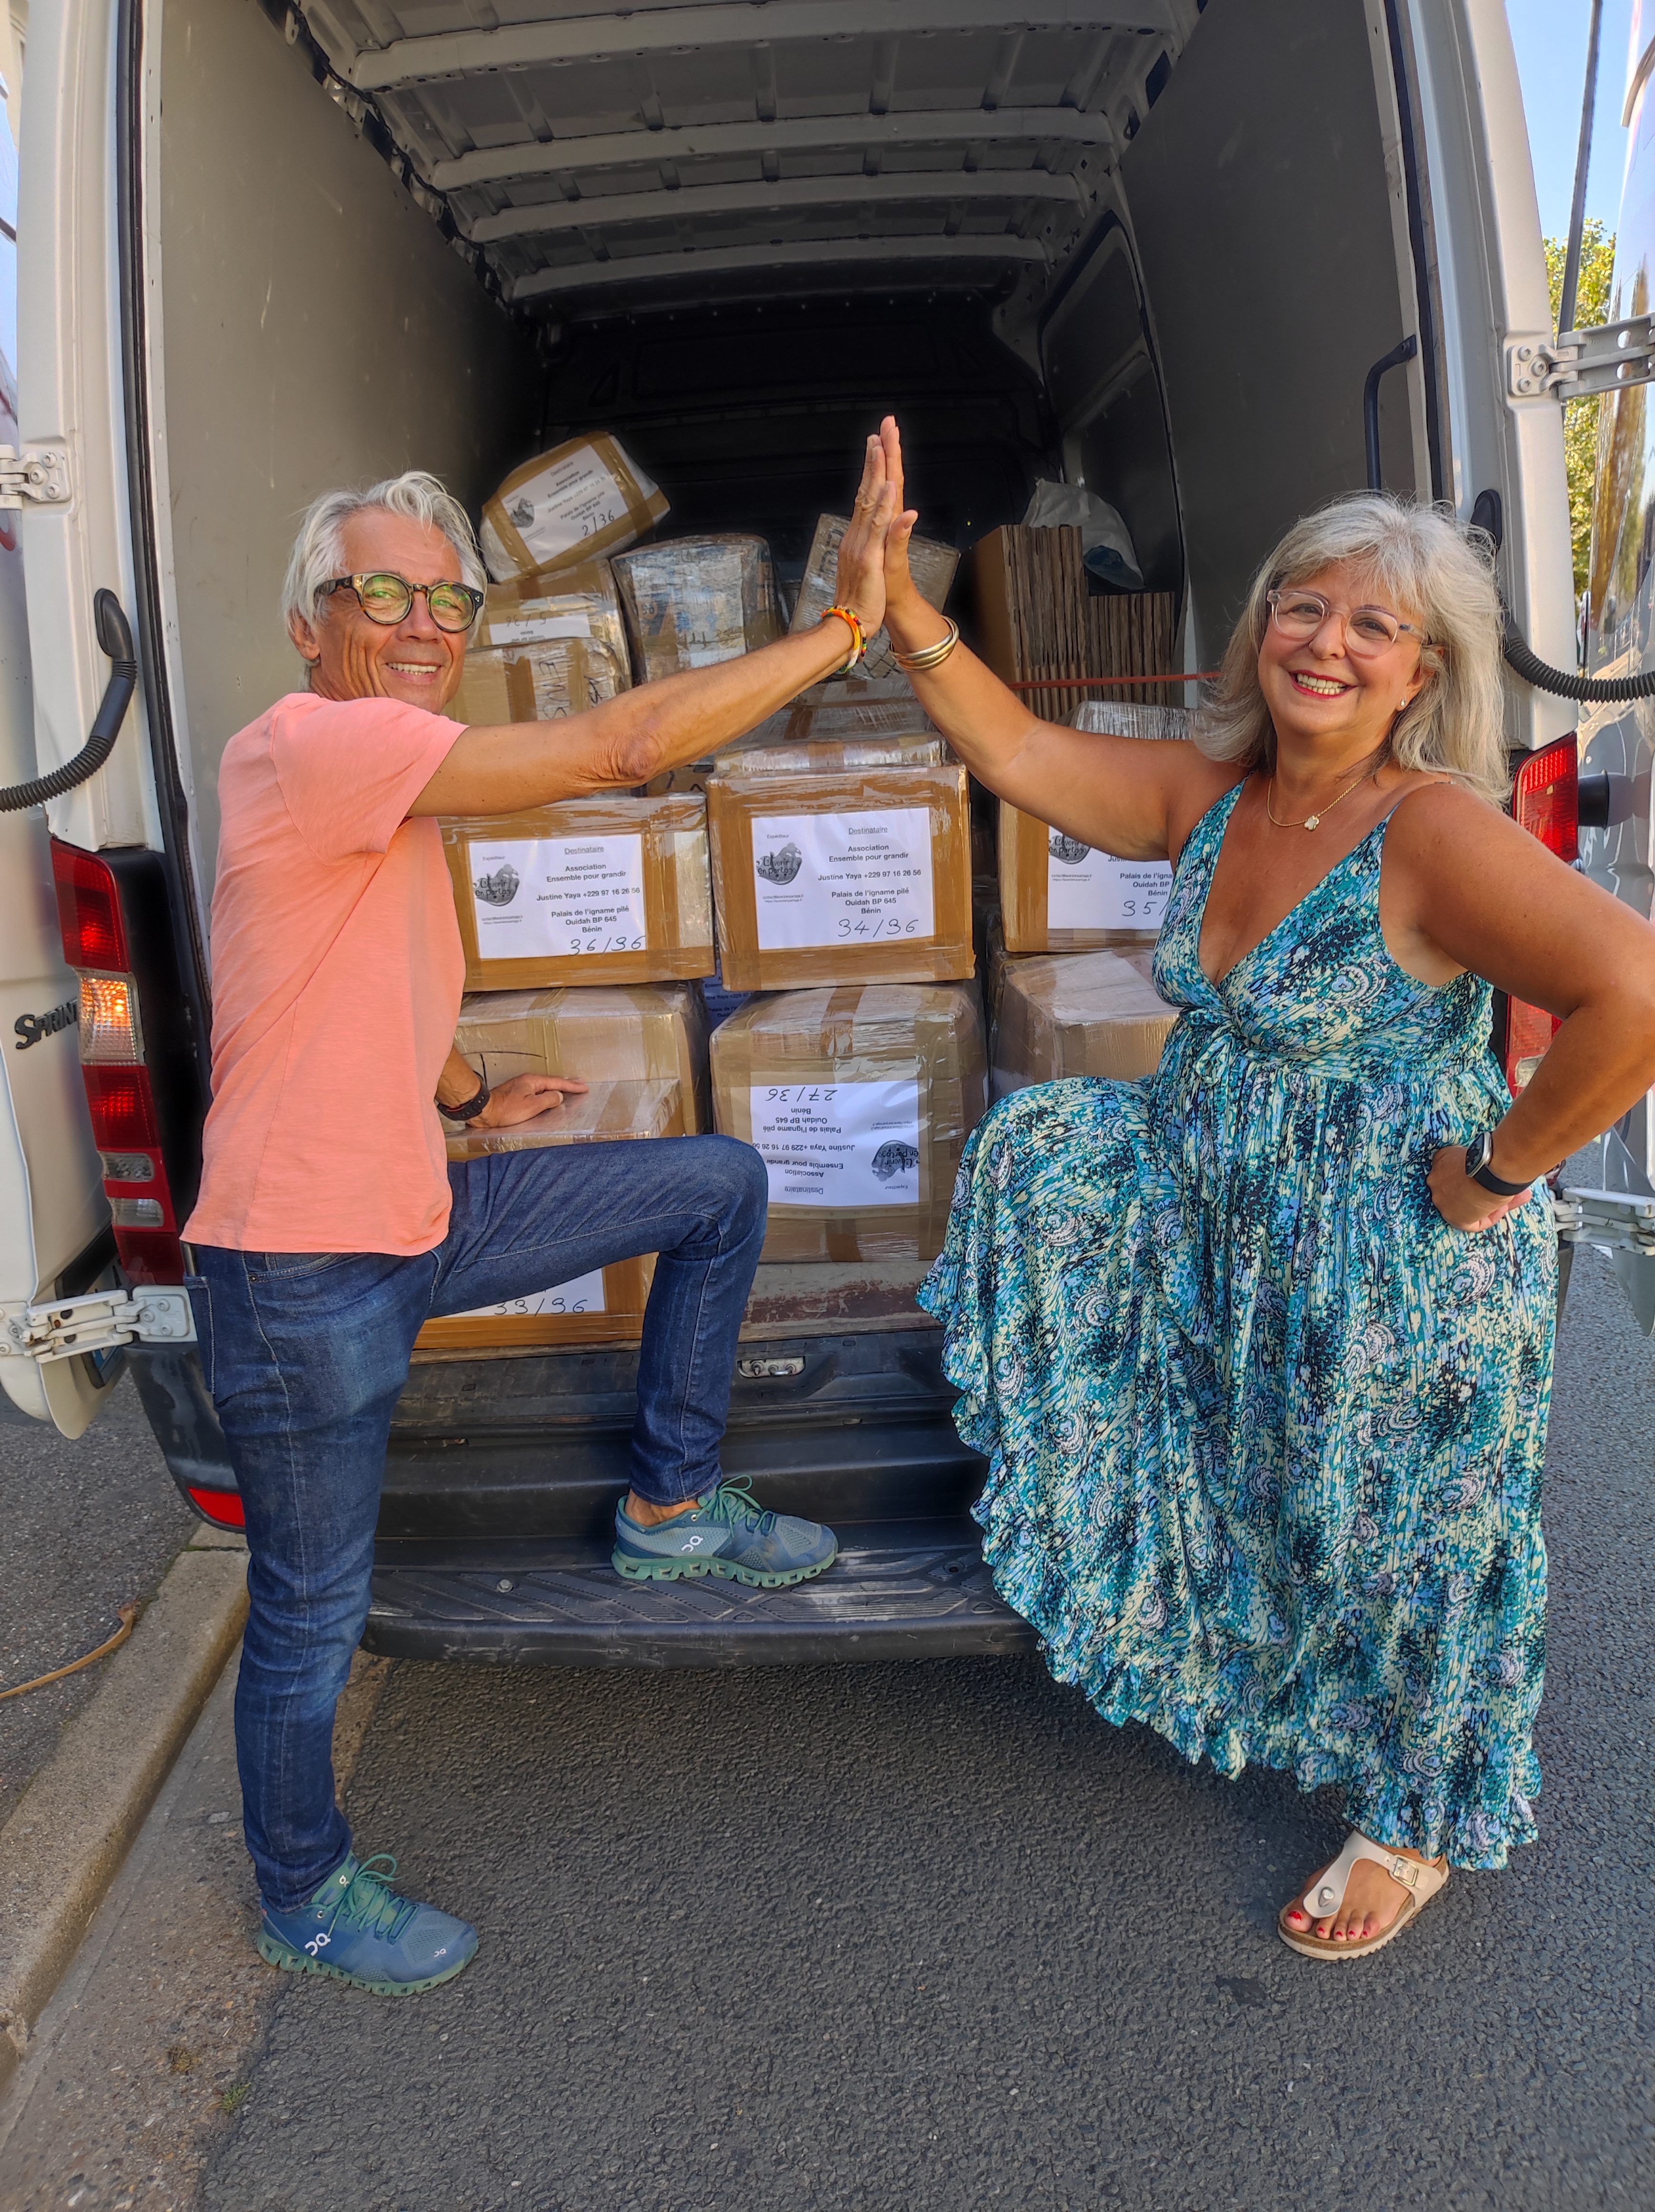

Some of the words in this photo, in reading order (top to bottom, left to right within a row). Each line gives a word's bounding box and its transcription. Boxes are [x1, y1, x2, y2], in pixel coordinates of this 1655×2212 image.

[848, 827, 888, 835] Destinataire
[564, 847, 604, 855] Destinataire
[848, 844, 889, 852] Association
[884, 852, 909, 860] grandir
[565, 863, 606, 872] Association
[547, 874, 582, 882] Ensemble
[583, 872, 599, 881] pour
[602, 871, 626, 880] grandir
[865, 889, 895, 897] l'igname
[897, 887, 909, 895] pilé
[537, 893, 562, 901] Justine
[585, 907, 614, 916] l'igname
[617, 905, 629, 913] pilé
[1122, 901, 1168, 916] 35/
[810, 1144, 827, 1152] Yaya
[785, 1169, 824, 1178] Association
[784, 1186, 823, 1195] Destinataire
